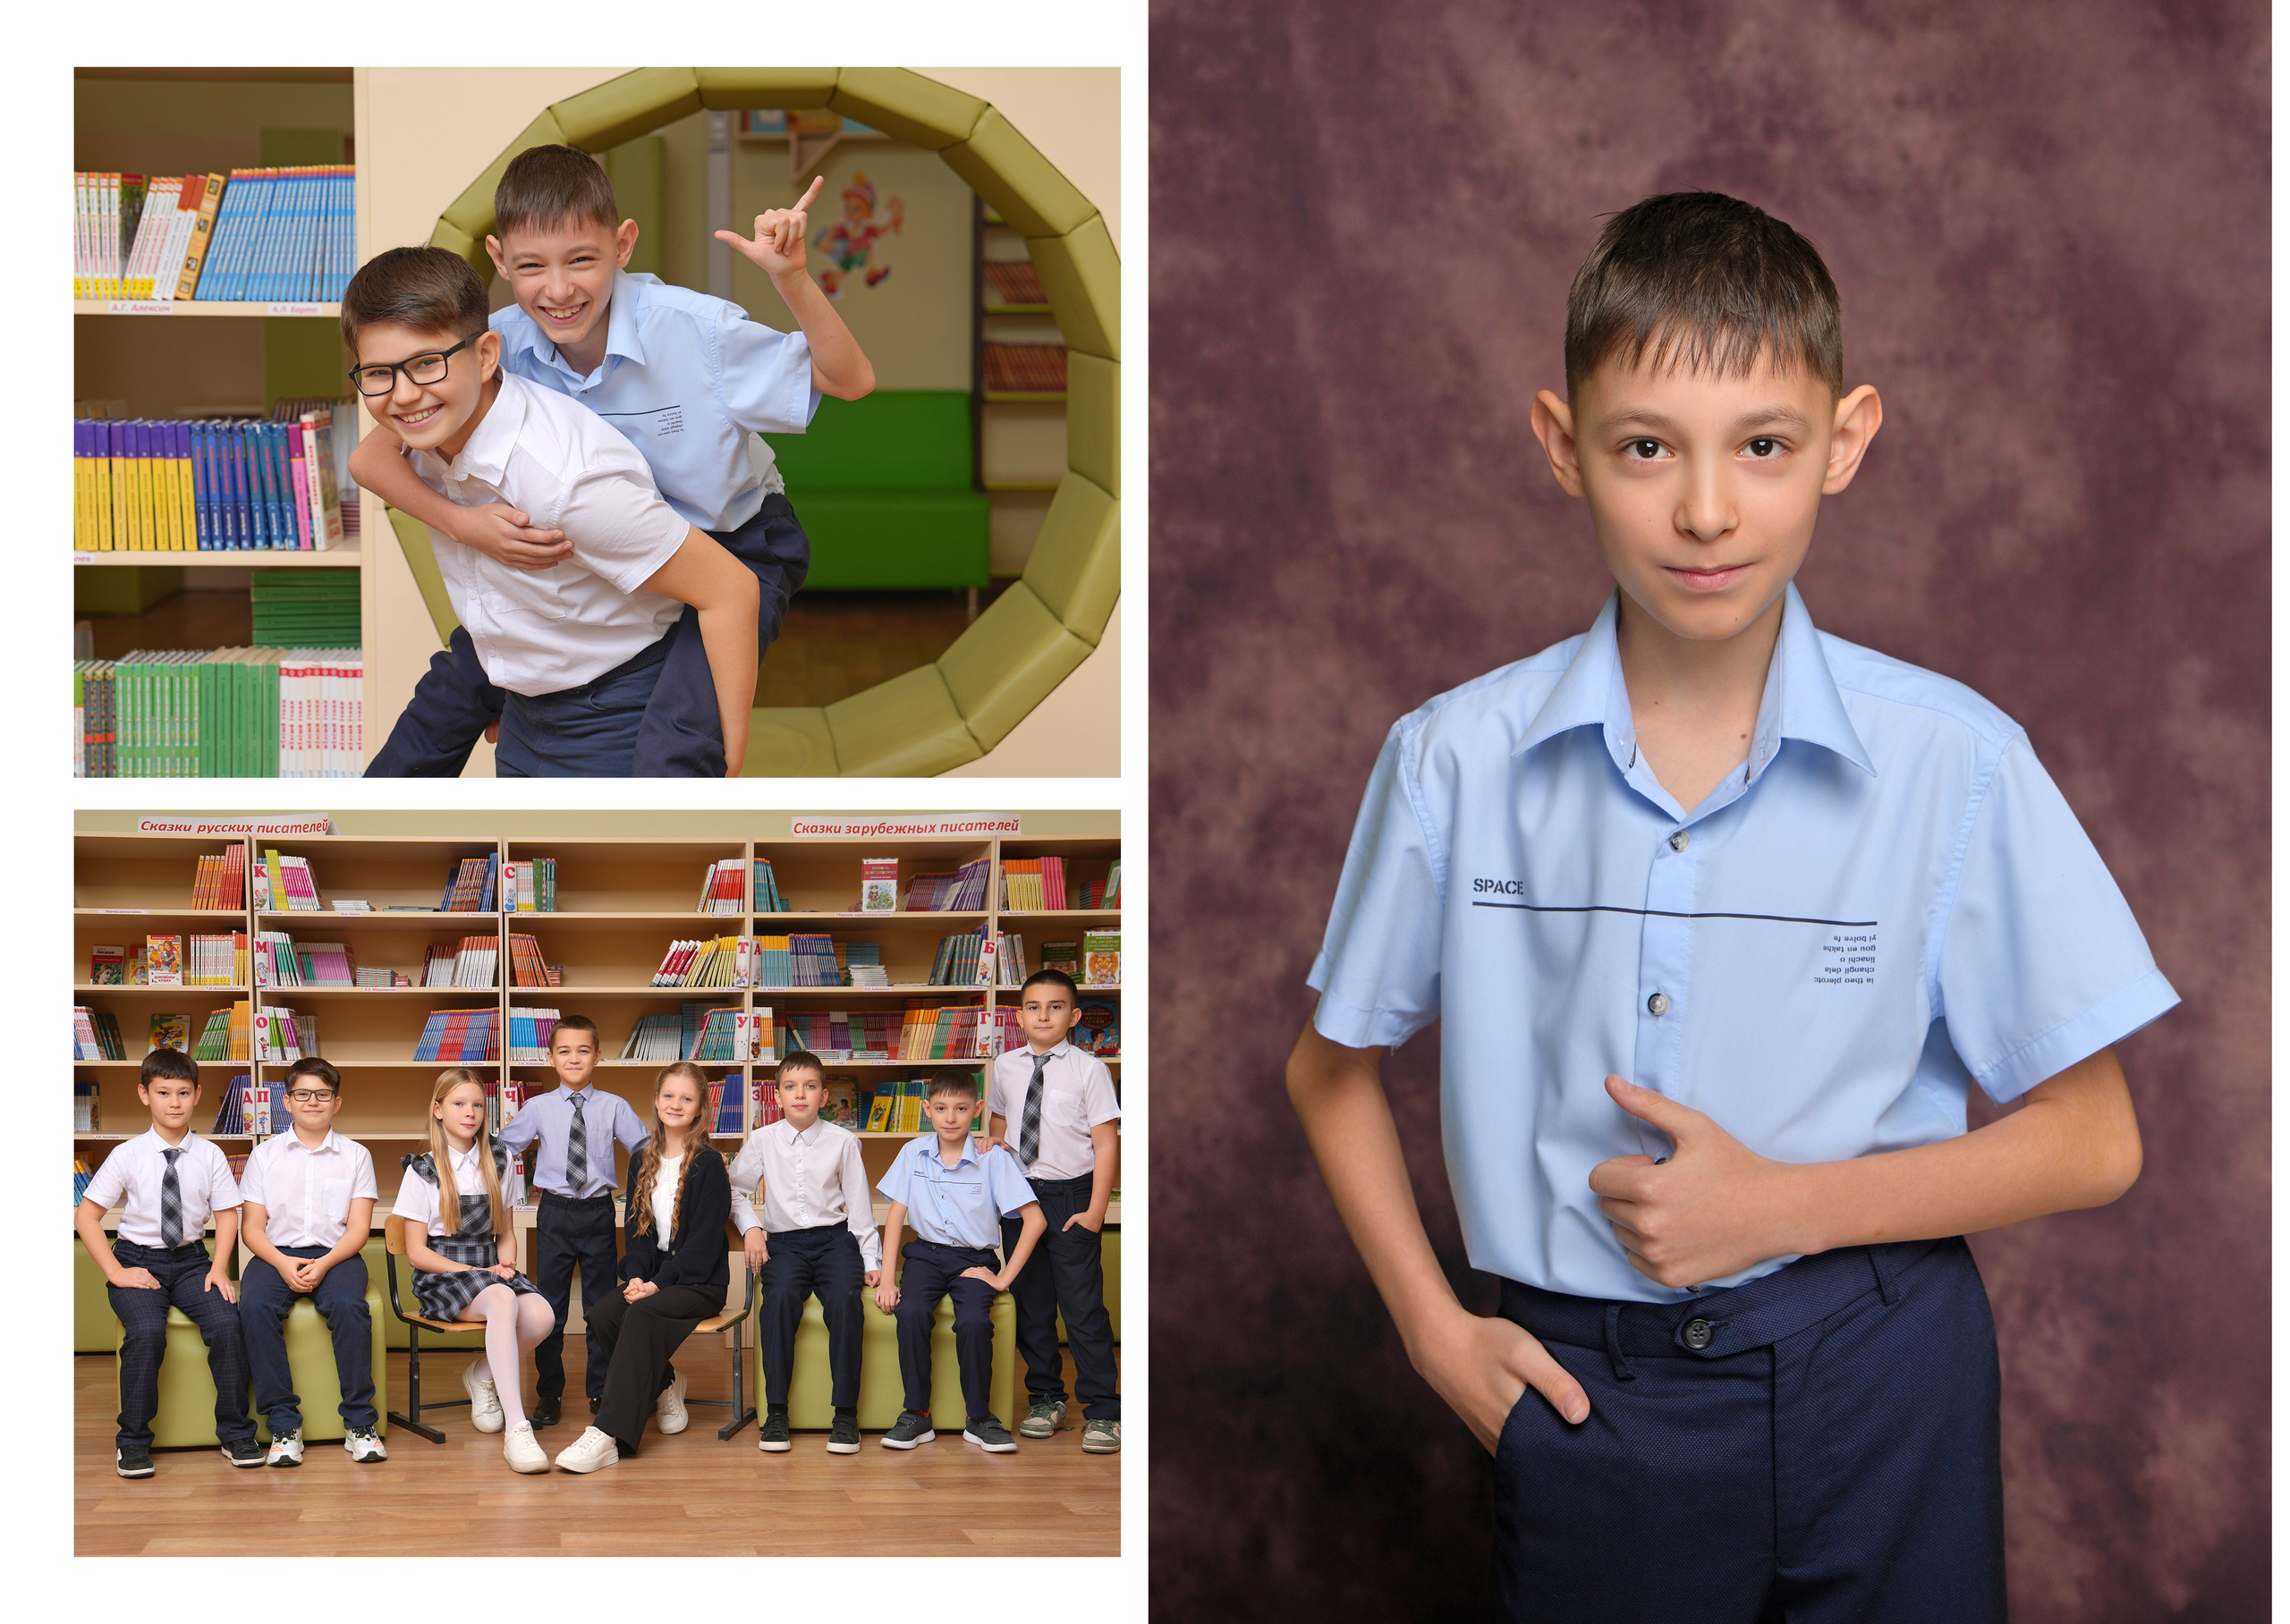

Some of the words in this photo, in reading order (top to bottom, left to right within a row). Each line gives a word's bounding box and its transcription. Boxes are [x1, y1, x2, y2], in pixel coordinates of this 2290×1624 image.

[131, 304, 171, 312] Алексин
[140, 820, 192, 832] Сказки
[196, 824, 253, 834] русских
[257, 818, 328, 833] писателей
[793, 822, 842, 833] Сказки
[844, 822, 937, 836] зарубежных
[939, 818, 1019, 833] писателей
[254, 866, 267, 878] К
[504, 867, 515, 879] С
[1473, 878, 1523, 894] SPACE
[255, 941, 267, 953] М
[738, 942, 749, 953] Т
[753, 943, 761, 955] А
[983, 942, 995, 954] Б
[256, 1017, 267, 1028] О
[736, 1016, 749, 1028] У
[753, 1016, 759, 1028] В
[980, 1012, 991, 1025] Г
[994, 1015, 1004, 1028] П
[243, 1090, 253, 1104] Д
[257, 1090, 269, 1103] П
[505, 1090, 516, 1103] Ч
[752, 1090, 760, 1101] З
